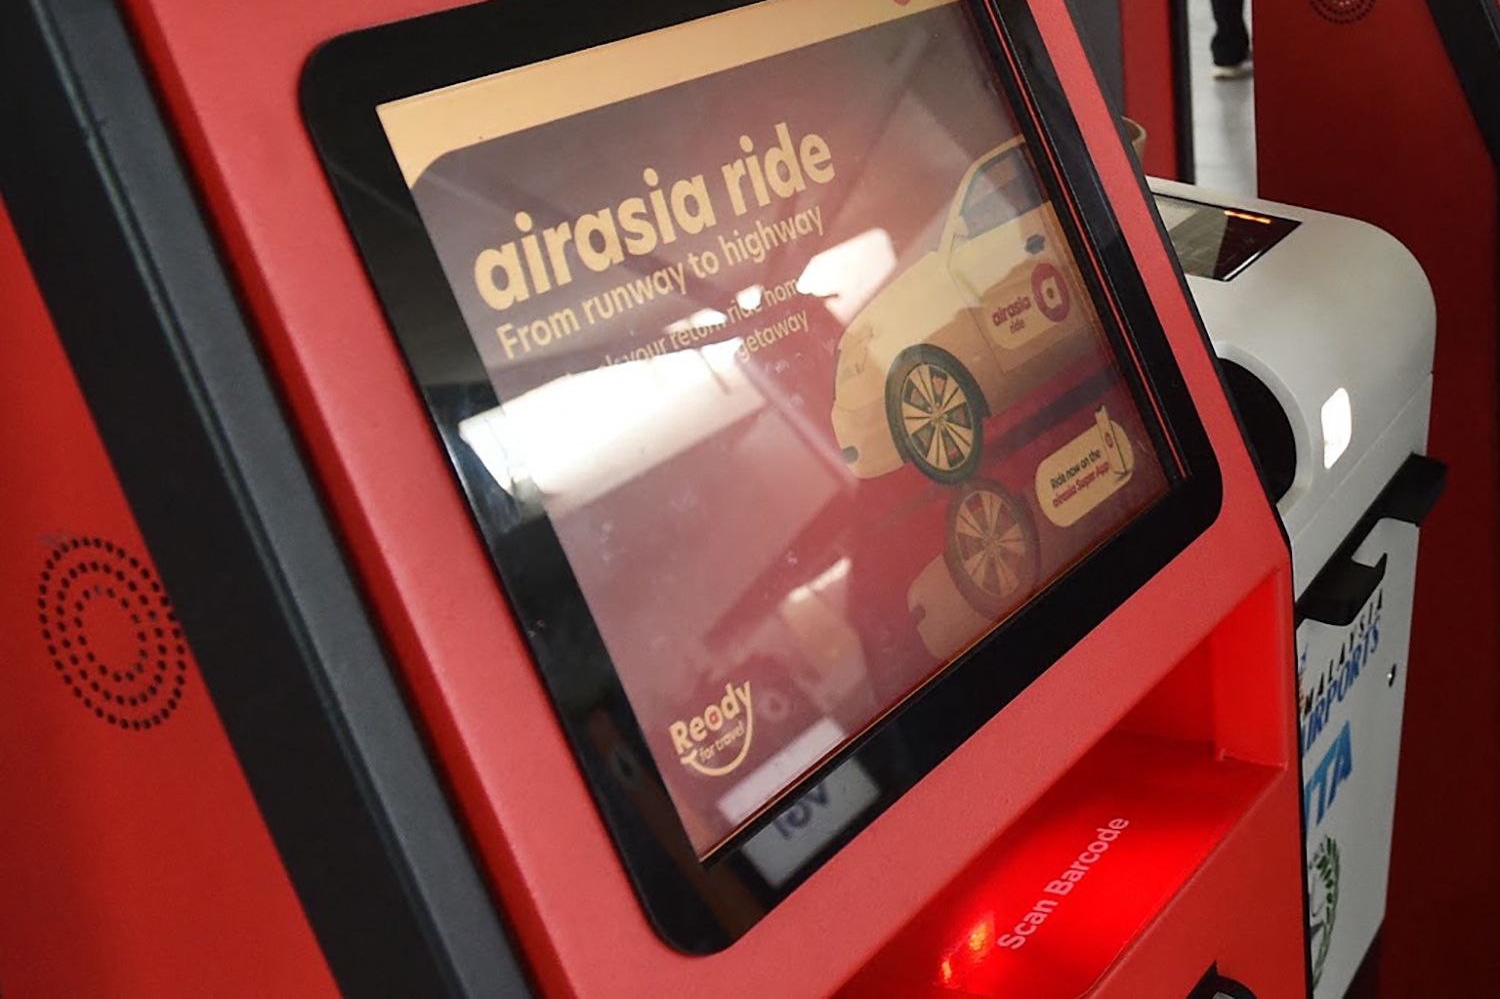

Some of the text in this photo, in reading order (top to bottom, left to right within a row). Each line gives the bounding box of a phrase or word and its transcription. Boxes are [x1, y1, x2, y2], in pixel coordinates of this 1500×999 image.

[474, 121, 836, 310] airasia ride
[495, 204, 825, 360] From runway to highway
[669, 320, 728, 350] retu
[727, 297, 762, 323] ri
[760, 279, 798, 307] hom
[738, 310, 809, 363] getaway
[699, 720, 745, 762] for travel
[997, 818, 1130, 950] Scan Barcode
